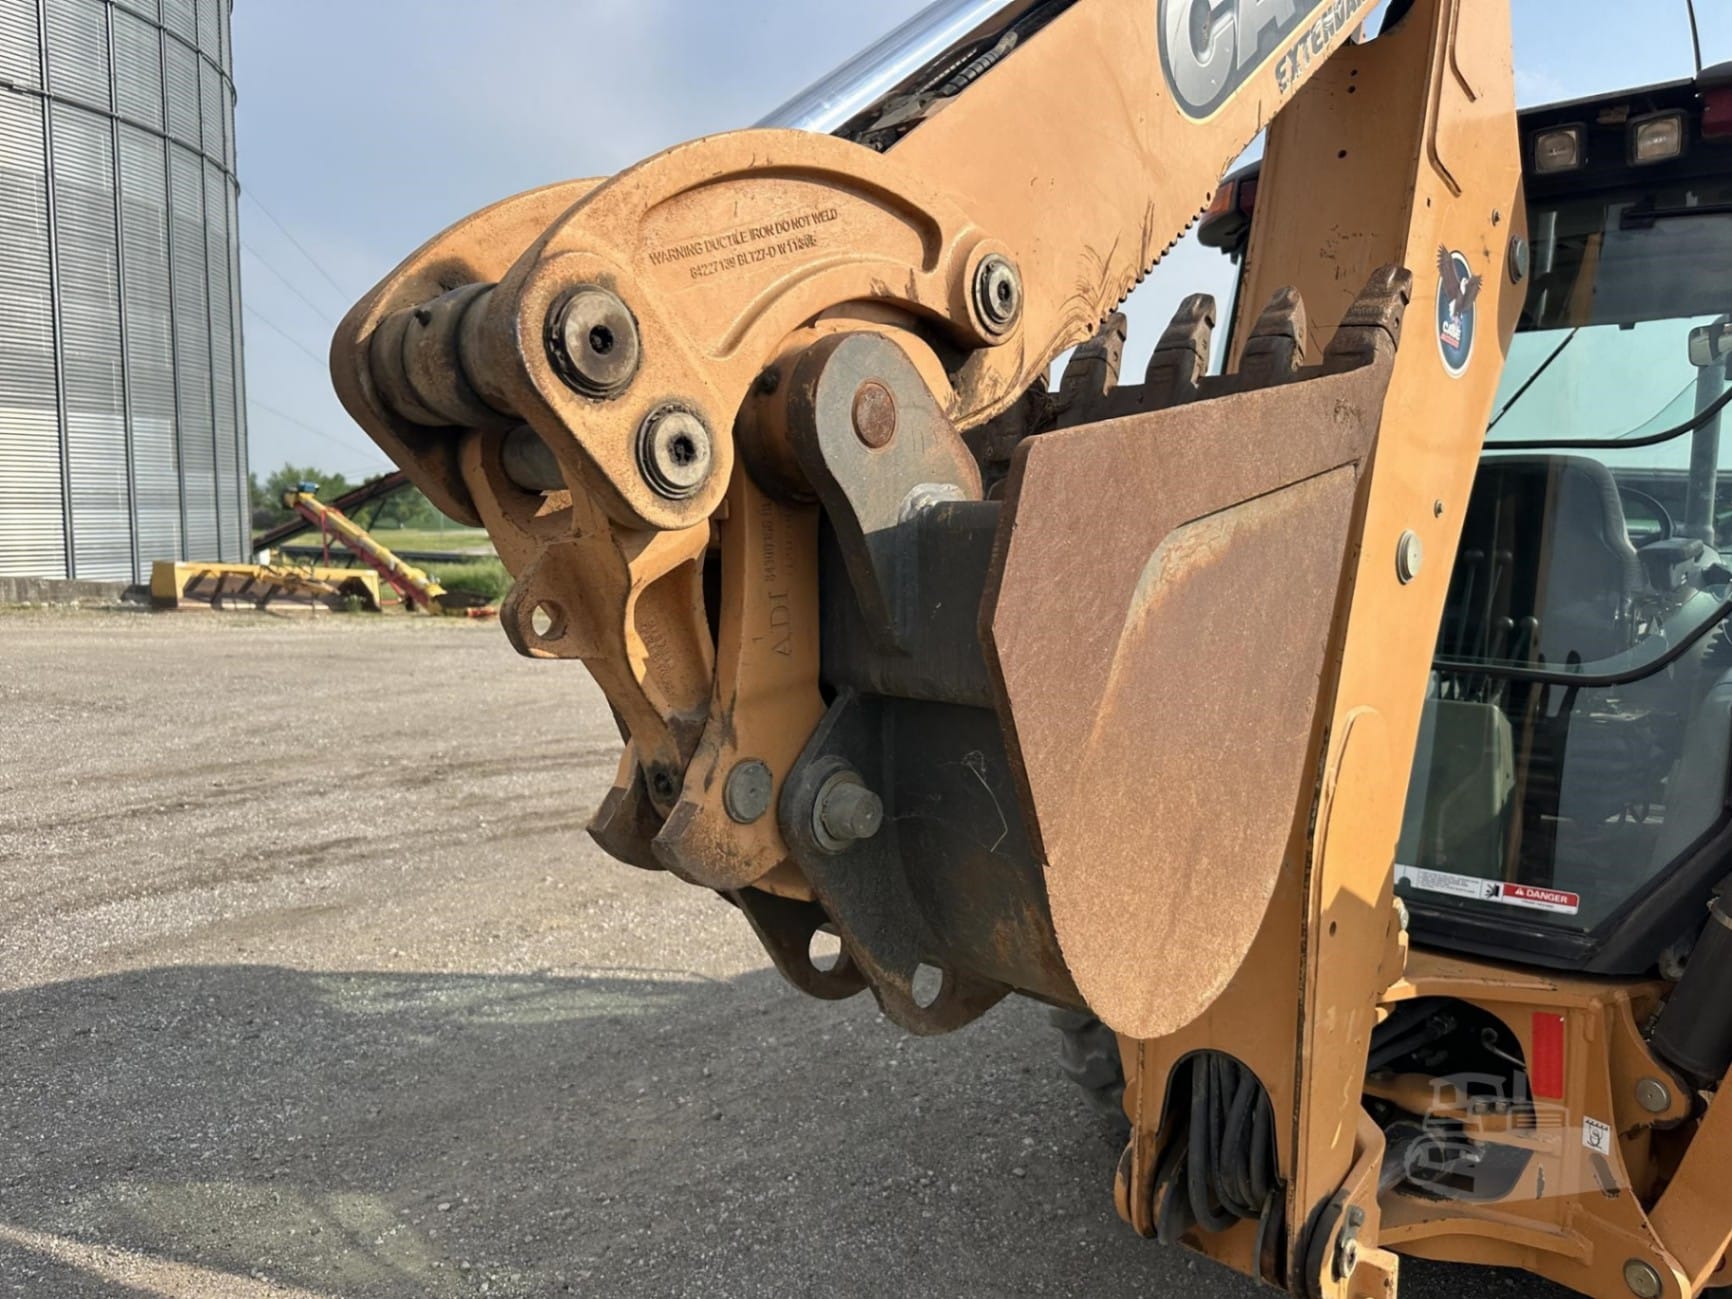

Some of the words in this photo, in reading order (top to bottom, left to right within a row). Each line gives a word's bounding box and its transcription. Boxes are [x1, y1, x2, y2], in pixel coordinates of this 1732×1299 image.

[648, 242, 704, 267] WARNING
[703, 231, 749, 253] DUCTILE
[749, 224, 776, 241] IRON
[774, 220, 791, 238] DO
[790, 215, 810, 231] NOT
[810, 208, 838, 224] WELD
[1525, 888, 1568, 904] DANGER
